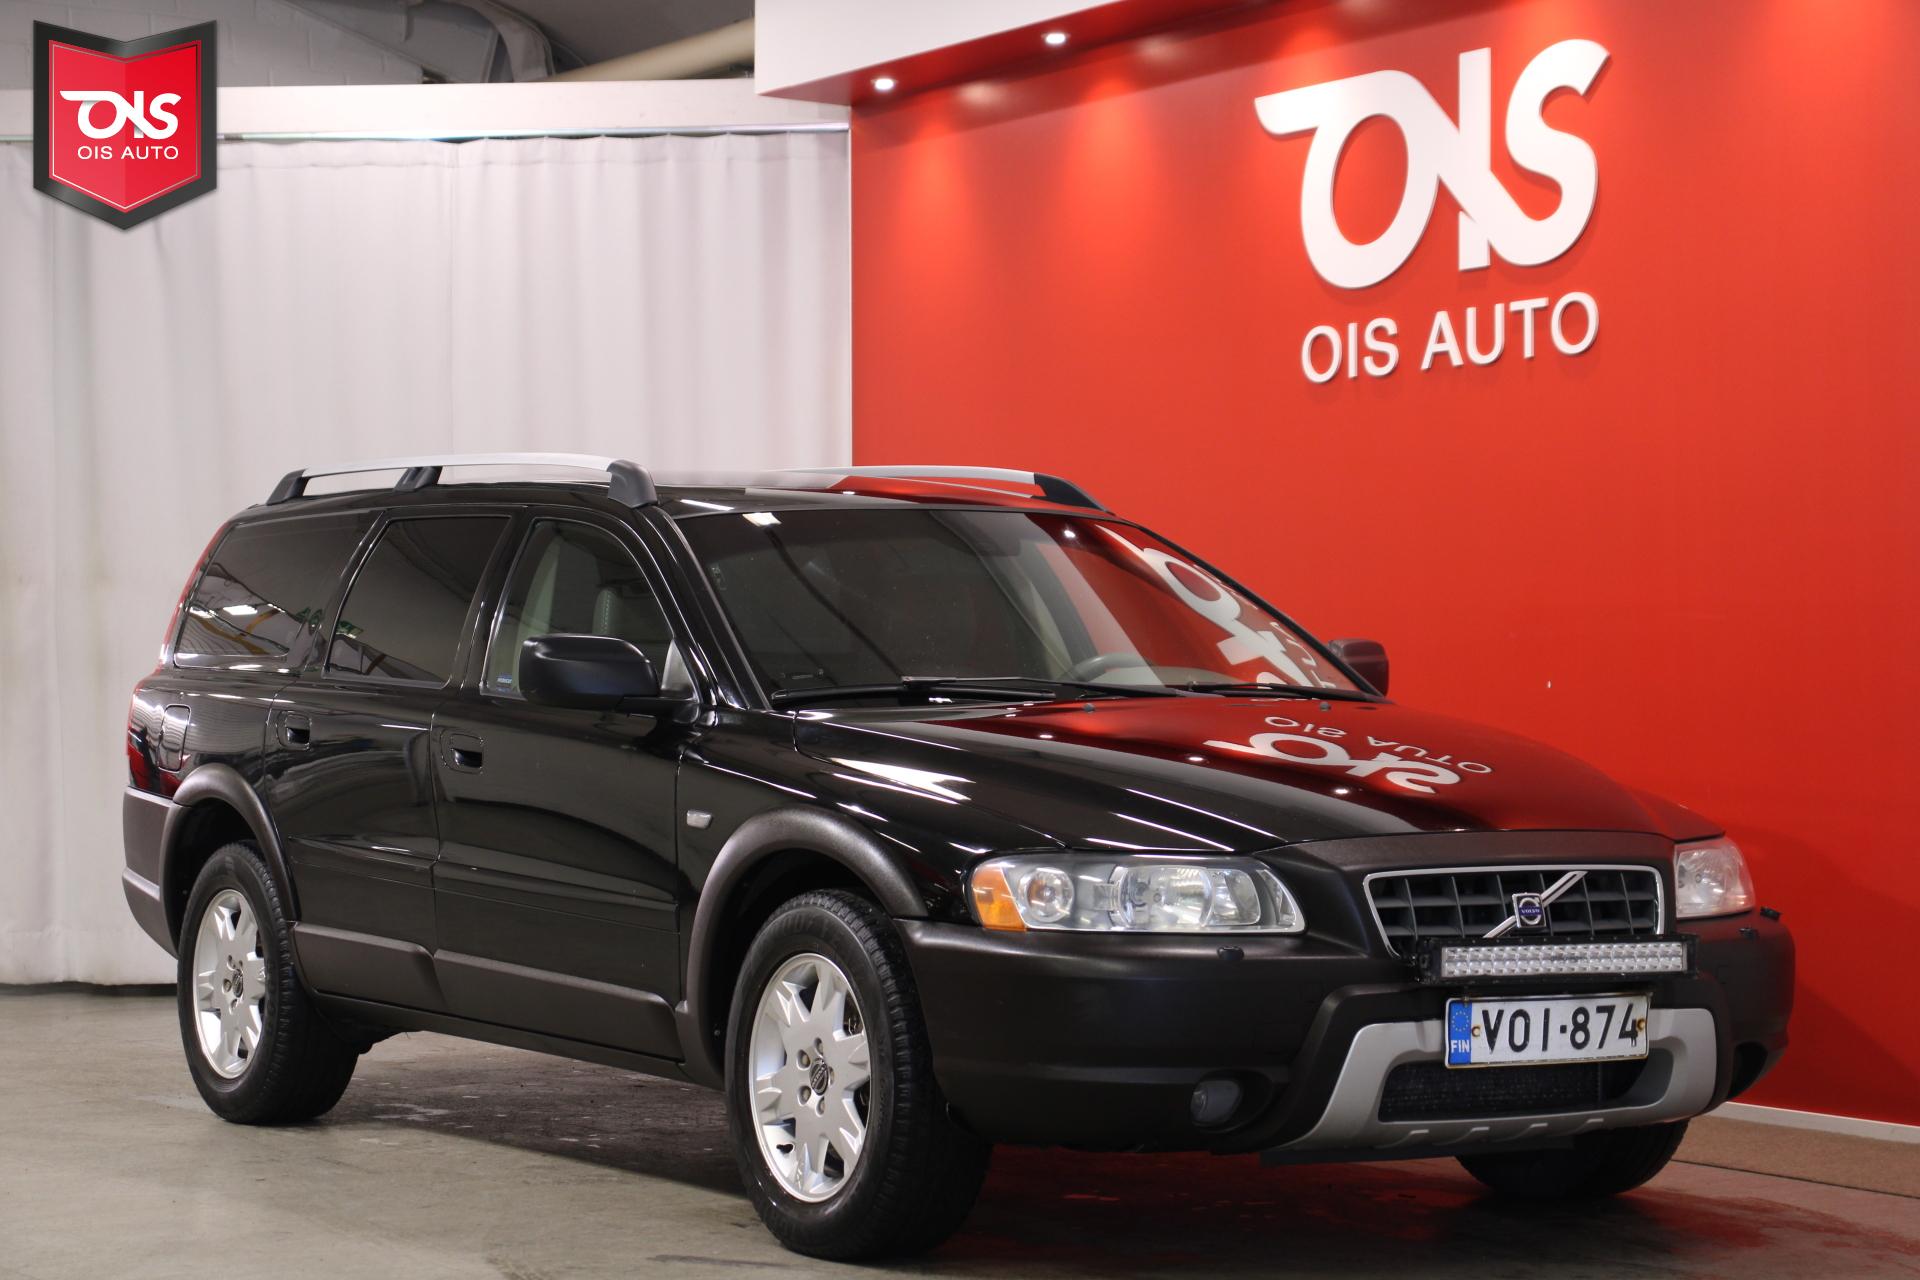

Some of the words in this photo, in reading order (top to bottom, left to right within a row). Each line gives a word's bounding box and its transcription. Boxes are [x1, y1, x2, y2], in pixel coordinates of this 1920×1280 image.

[1254, 38, 1611, 288] OIS
[1301, 317, 1400, 384] OIS
[1420, 291, 1600, 371] AUTO
[1450, 1039, 1471, 1053] FIN
[1481, 1003, 1639, 1054] VOI-874
